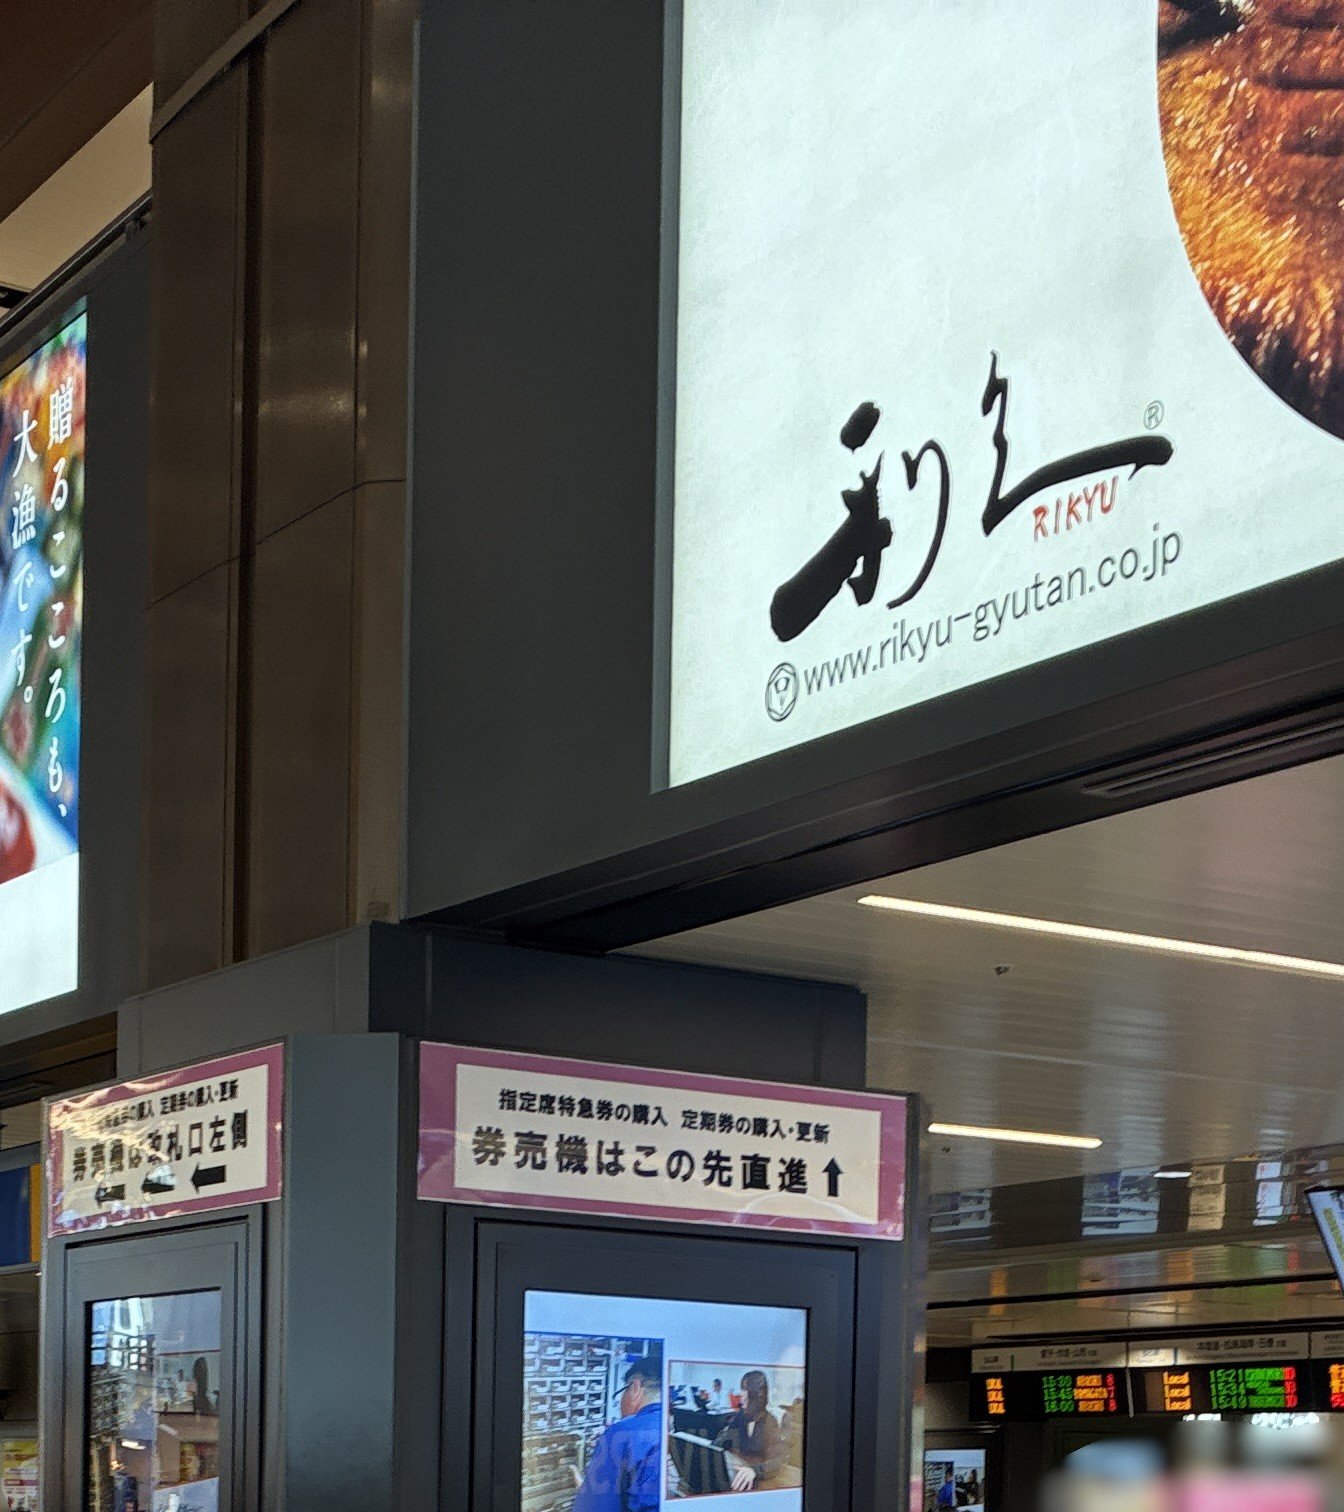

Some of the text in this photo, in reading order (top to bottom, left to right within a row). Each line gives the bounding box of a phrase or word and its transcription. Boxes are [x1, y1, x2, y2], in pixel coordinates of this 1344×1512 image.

[11, 409, 39, 704] 大漁です。
[1032, 475, 1120, 542] RIKYU
[45, 382, 74, 818] 贈るこころも、
[803, 521, 1183, 696] www.rikyu-gyutan.co.jp
[471, 1124, 809, 1195] 券売機はこの先直進
[498, 1087, 831, 1145] 指定席特急券の購入 定期券の購入・更新
